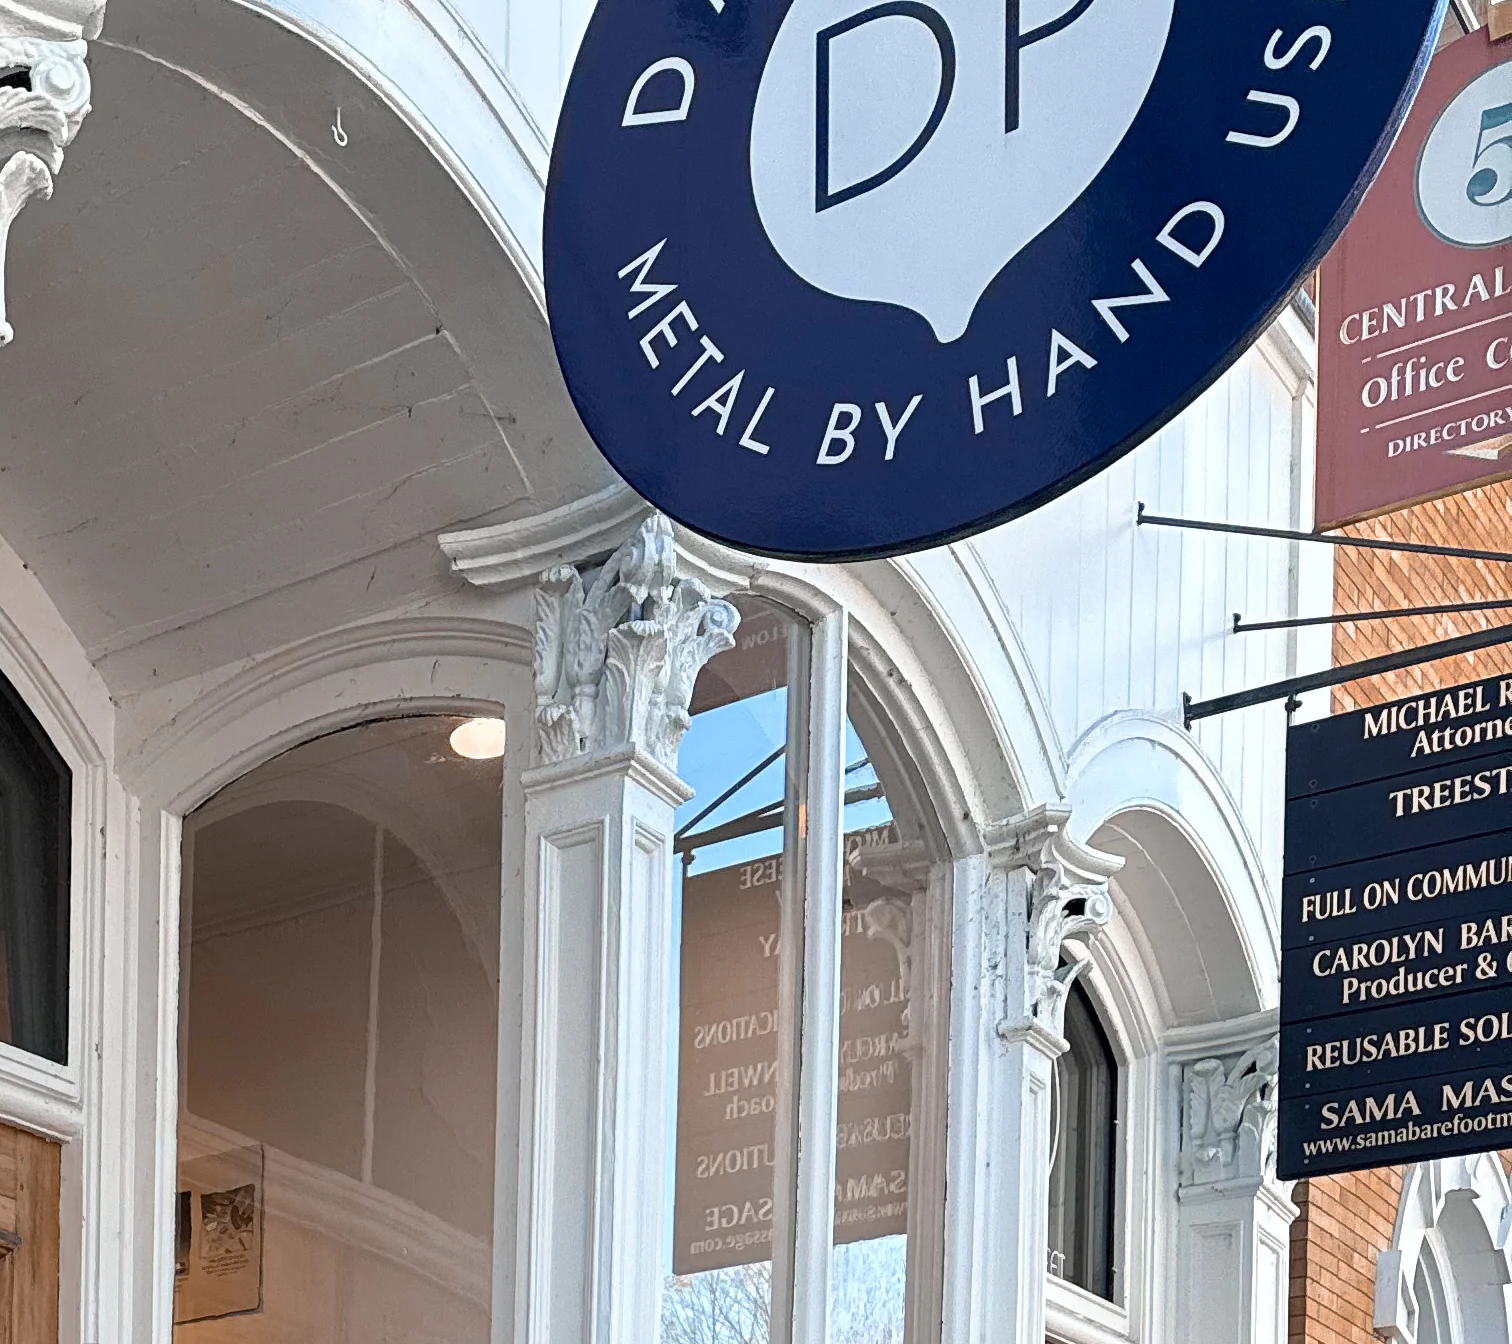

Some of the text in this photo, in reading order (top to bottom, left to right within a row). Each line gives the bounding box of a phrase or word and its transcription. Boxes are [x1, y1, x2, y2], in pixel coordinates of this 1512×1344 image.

[617, 24, 1333, 466] METAL BY HAND US
[1339, 265, 1512, 346] CENTRAL
[1361, 336, 1512, 409] Office C
[1364, 685, 1490, 740] MICHAEL
[1389, 765, 1512, 818] TREEST
[1301, 855, 1512, 923] FULL ON COMMU
[1313, 927, 1445, 978] CAROLYN
[1342, 961, 1468, 1004] Producer
[1475, 952, 1498, 980] &
[1306, 1021, 1450, 1072] REUSABLE
[1321, 1090, 1422, 1130] SAMA
